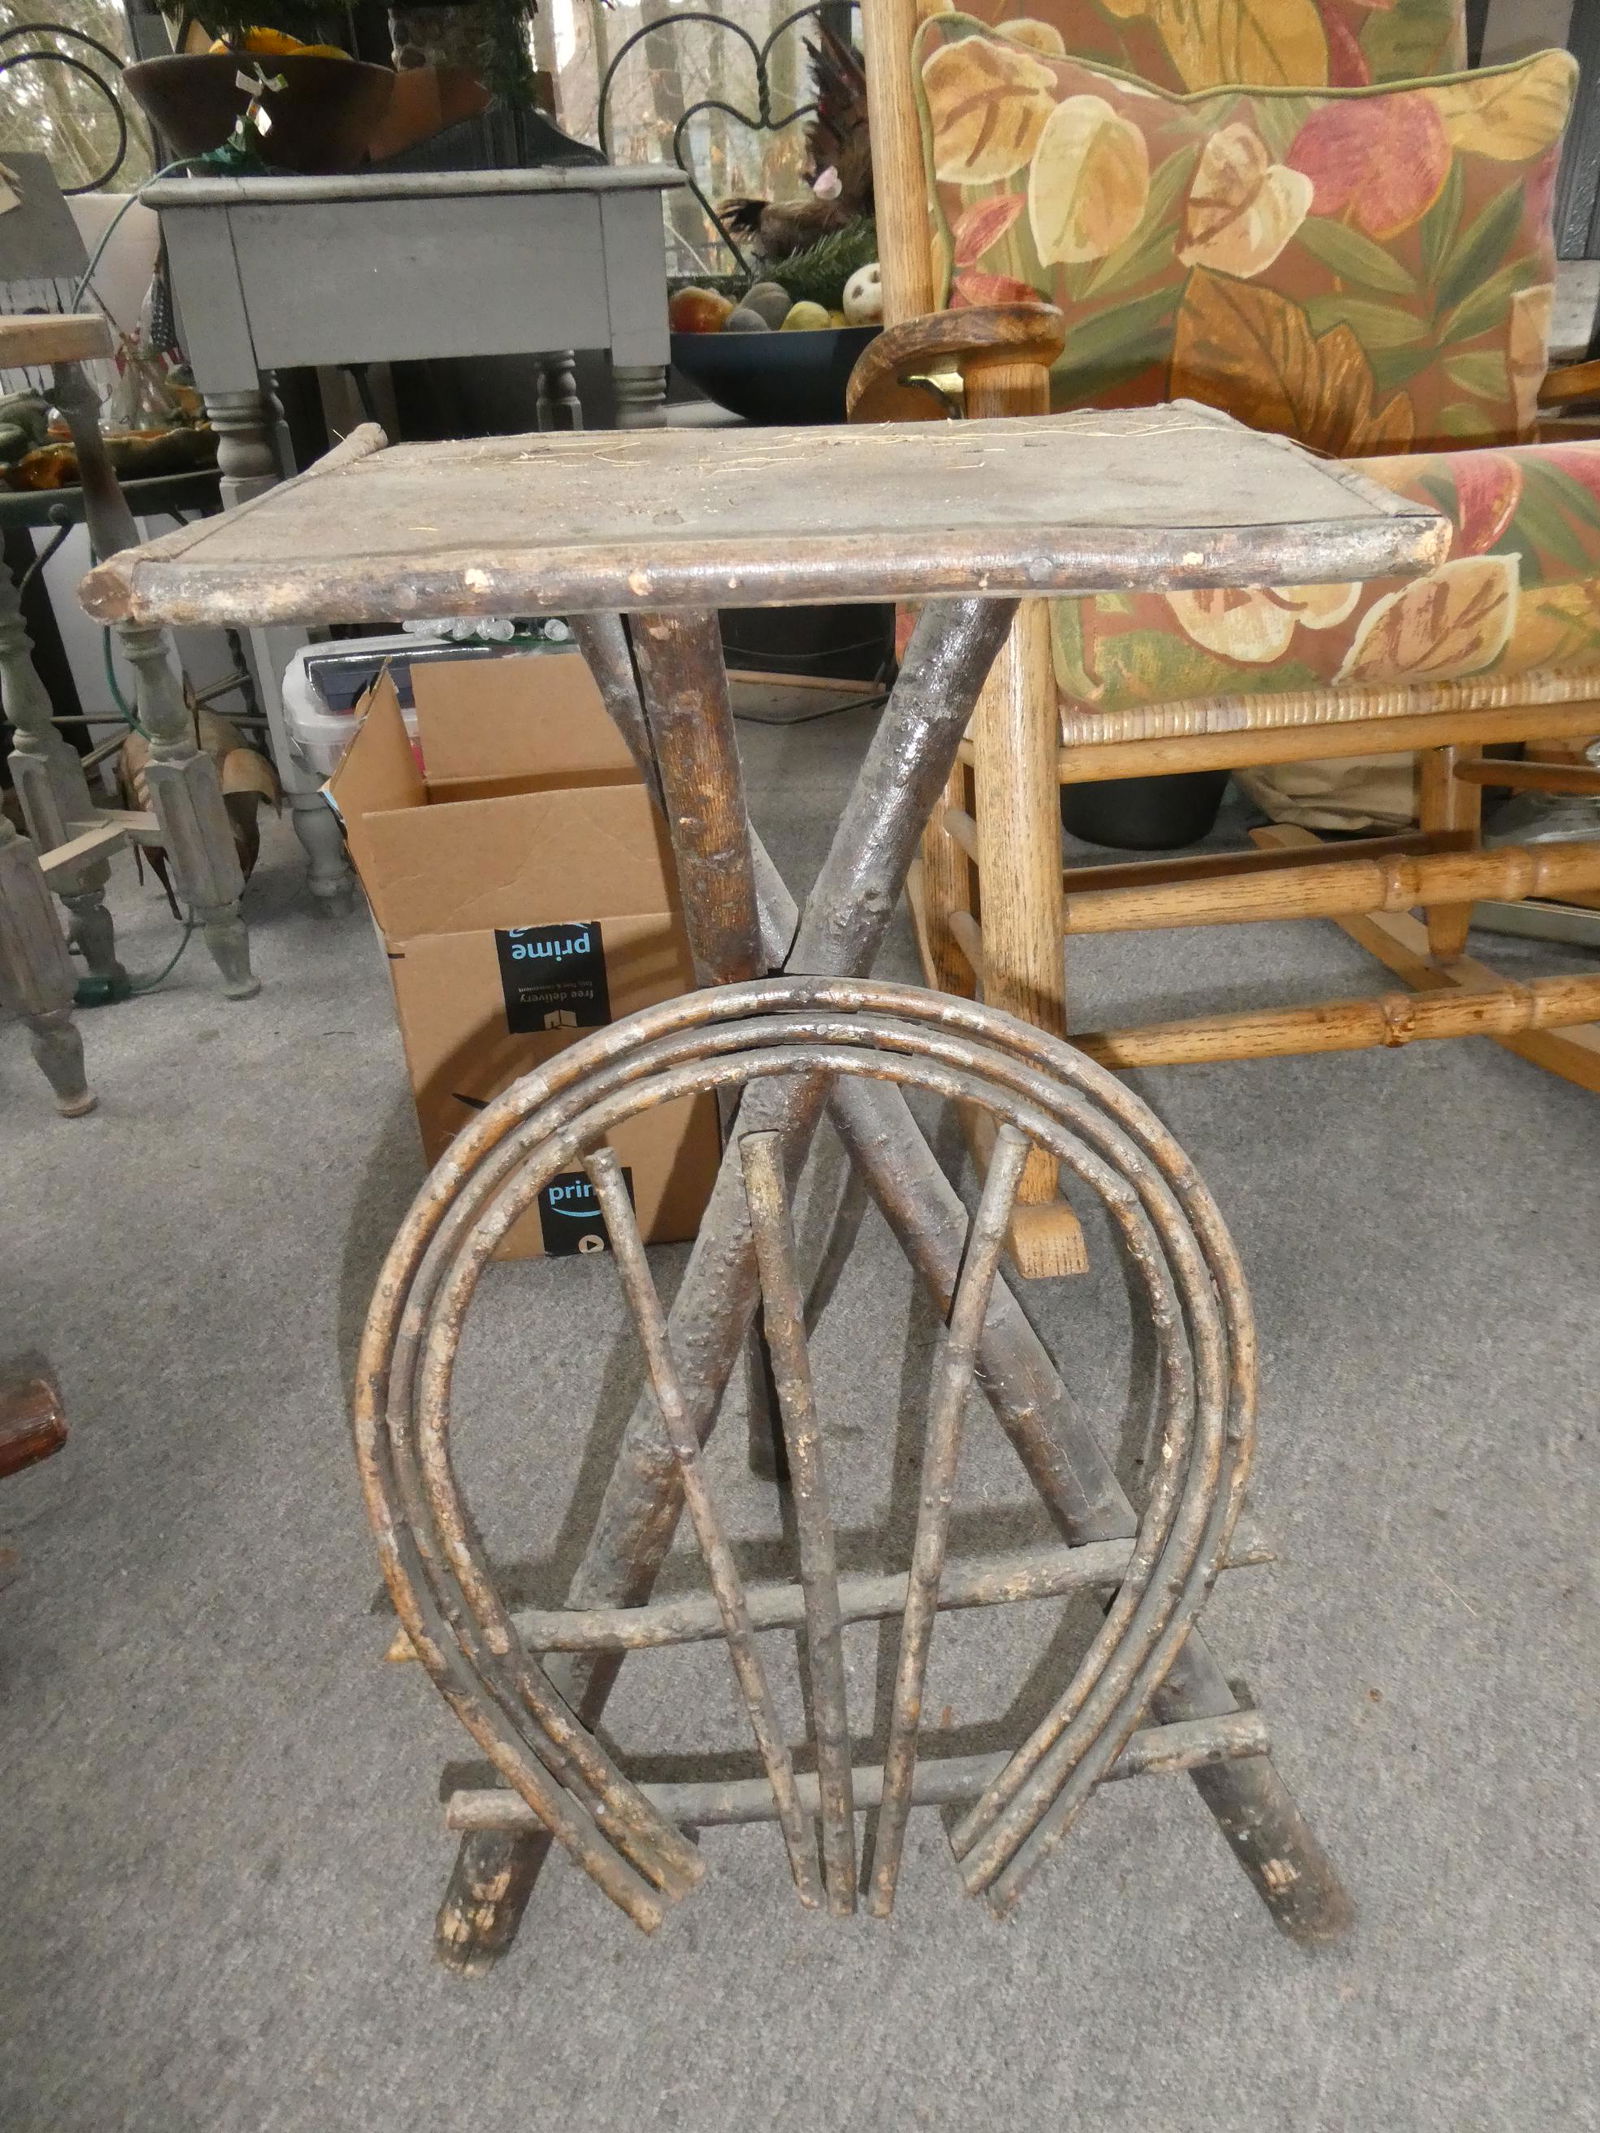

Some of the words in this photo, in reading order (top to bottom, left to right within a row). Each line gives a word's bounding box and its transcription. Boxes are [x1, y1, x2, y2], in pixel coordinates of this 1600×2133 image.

[511, 933, 591, 961] prime
[519, 991, 568, 1003] delivery
[571, 989, 594, 999] free
[548, 1180, 594, 1205] pri
